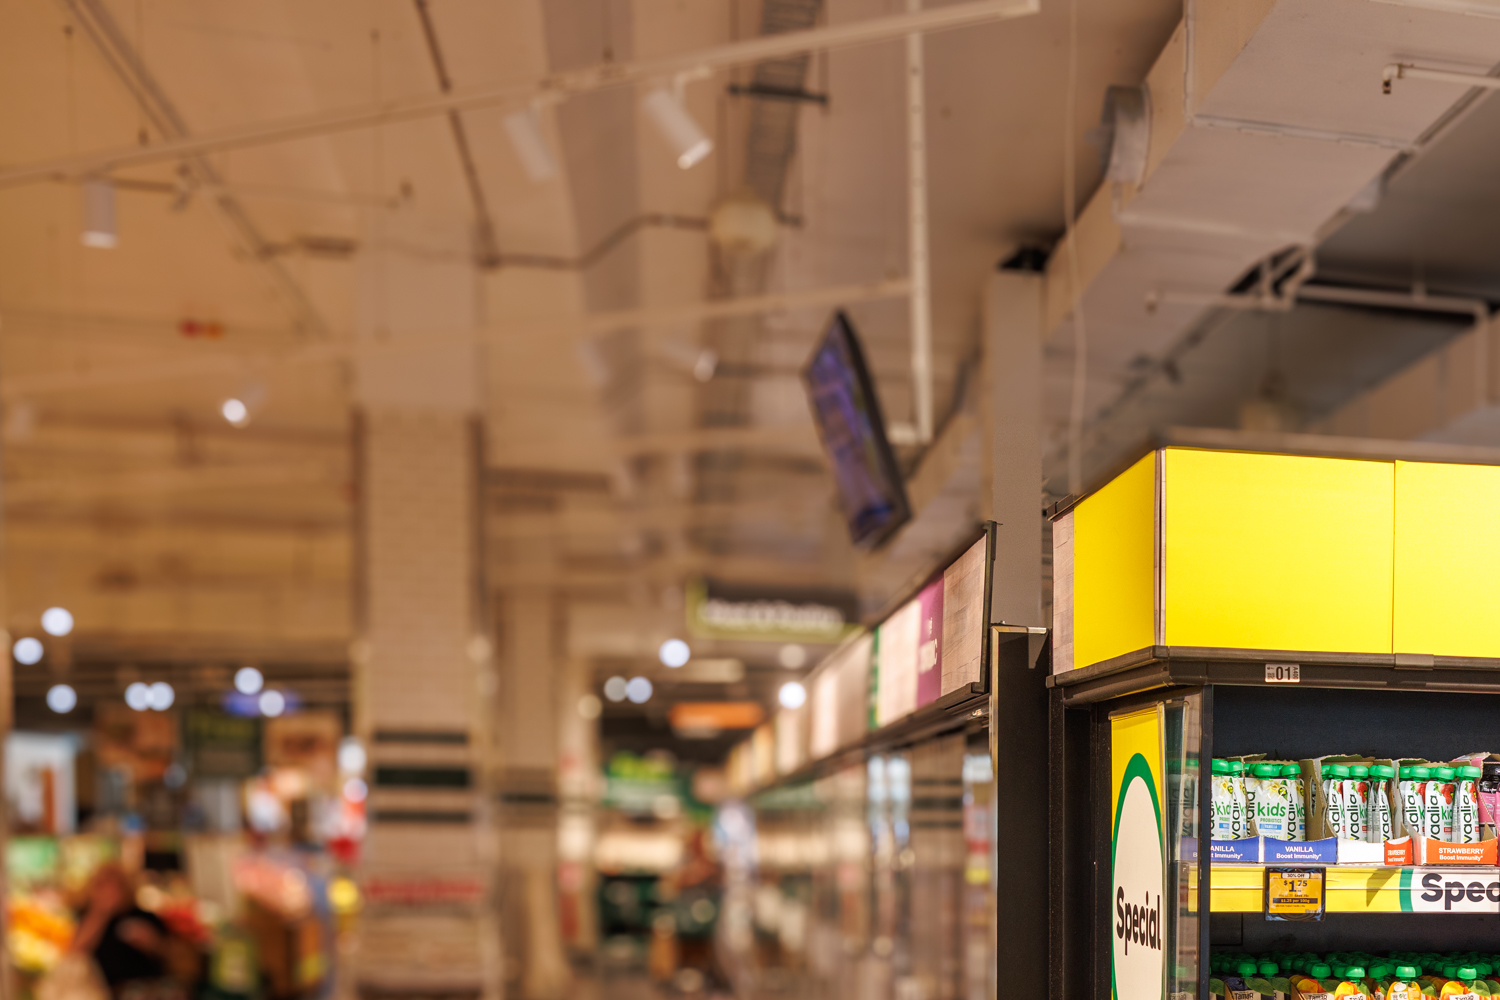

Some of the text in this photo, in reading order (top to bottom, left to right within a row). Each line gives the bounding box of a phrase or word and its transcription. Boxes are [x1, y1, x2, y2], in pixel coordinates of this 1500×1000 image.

[1276, 667, 1291, 680] 01
[1258, 802, 1285, 817] kids
[1116, 886, 1161, 956] Special
